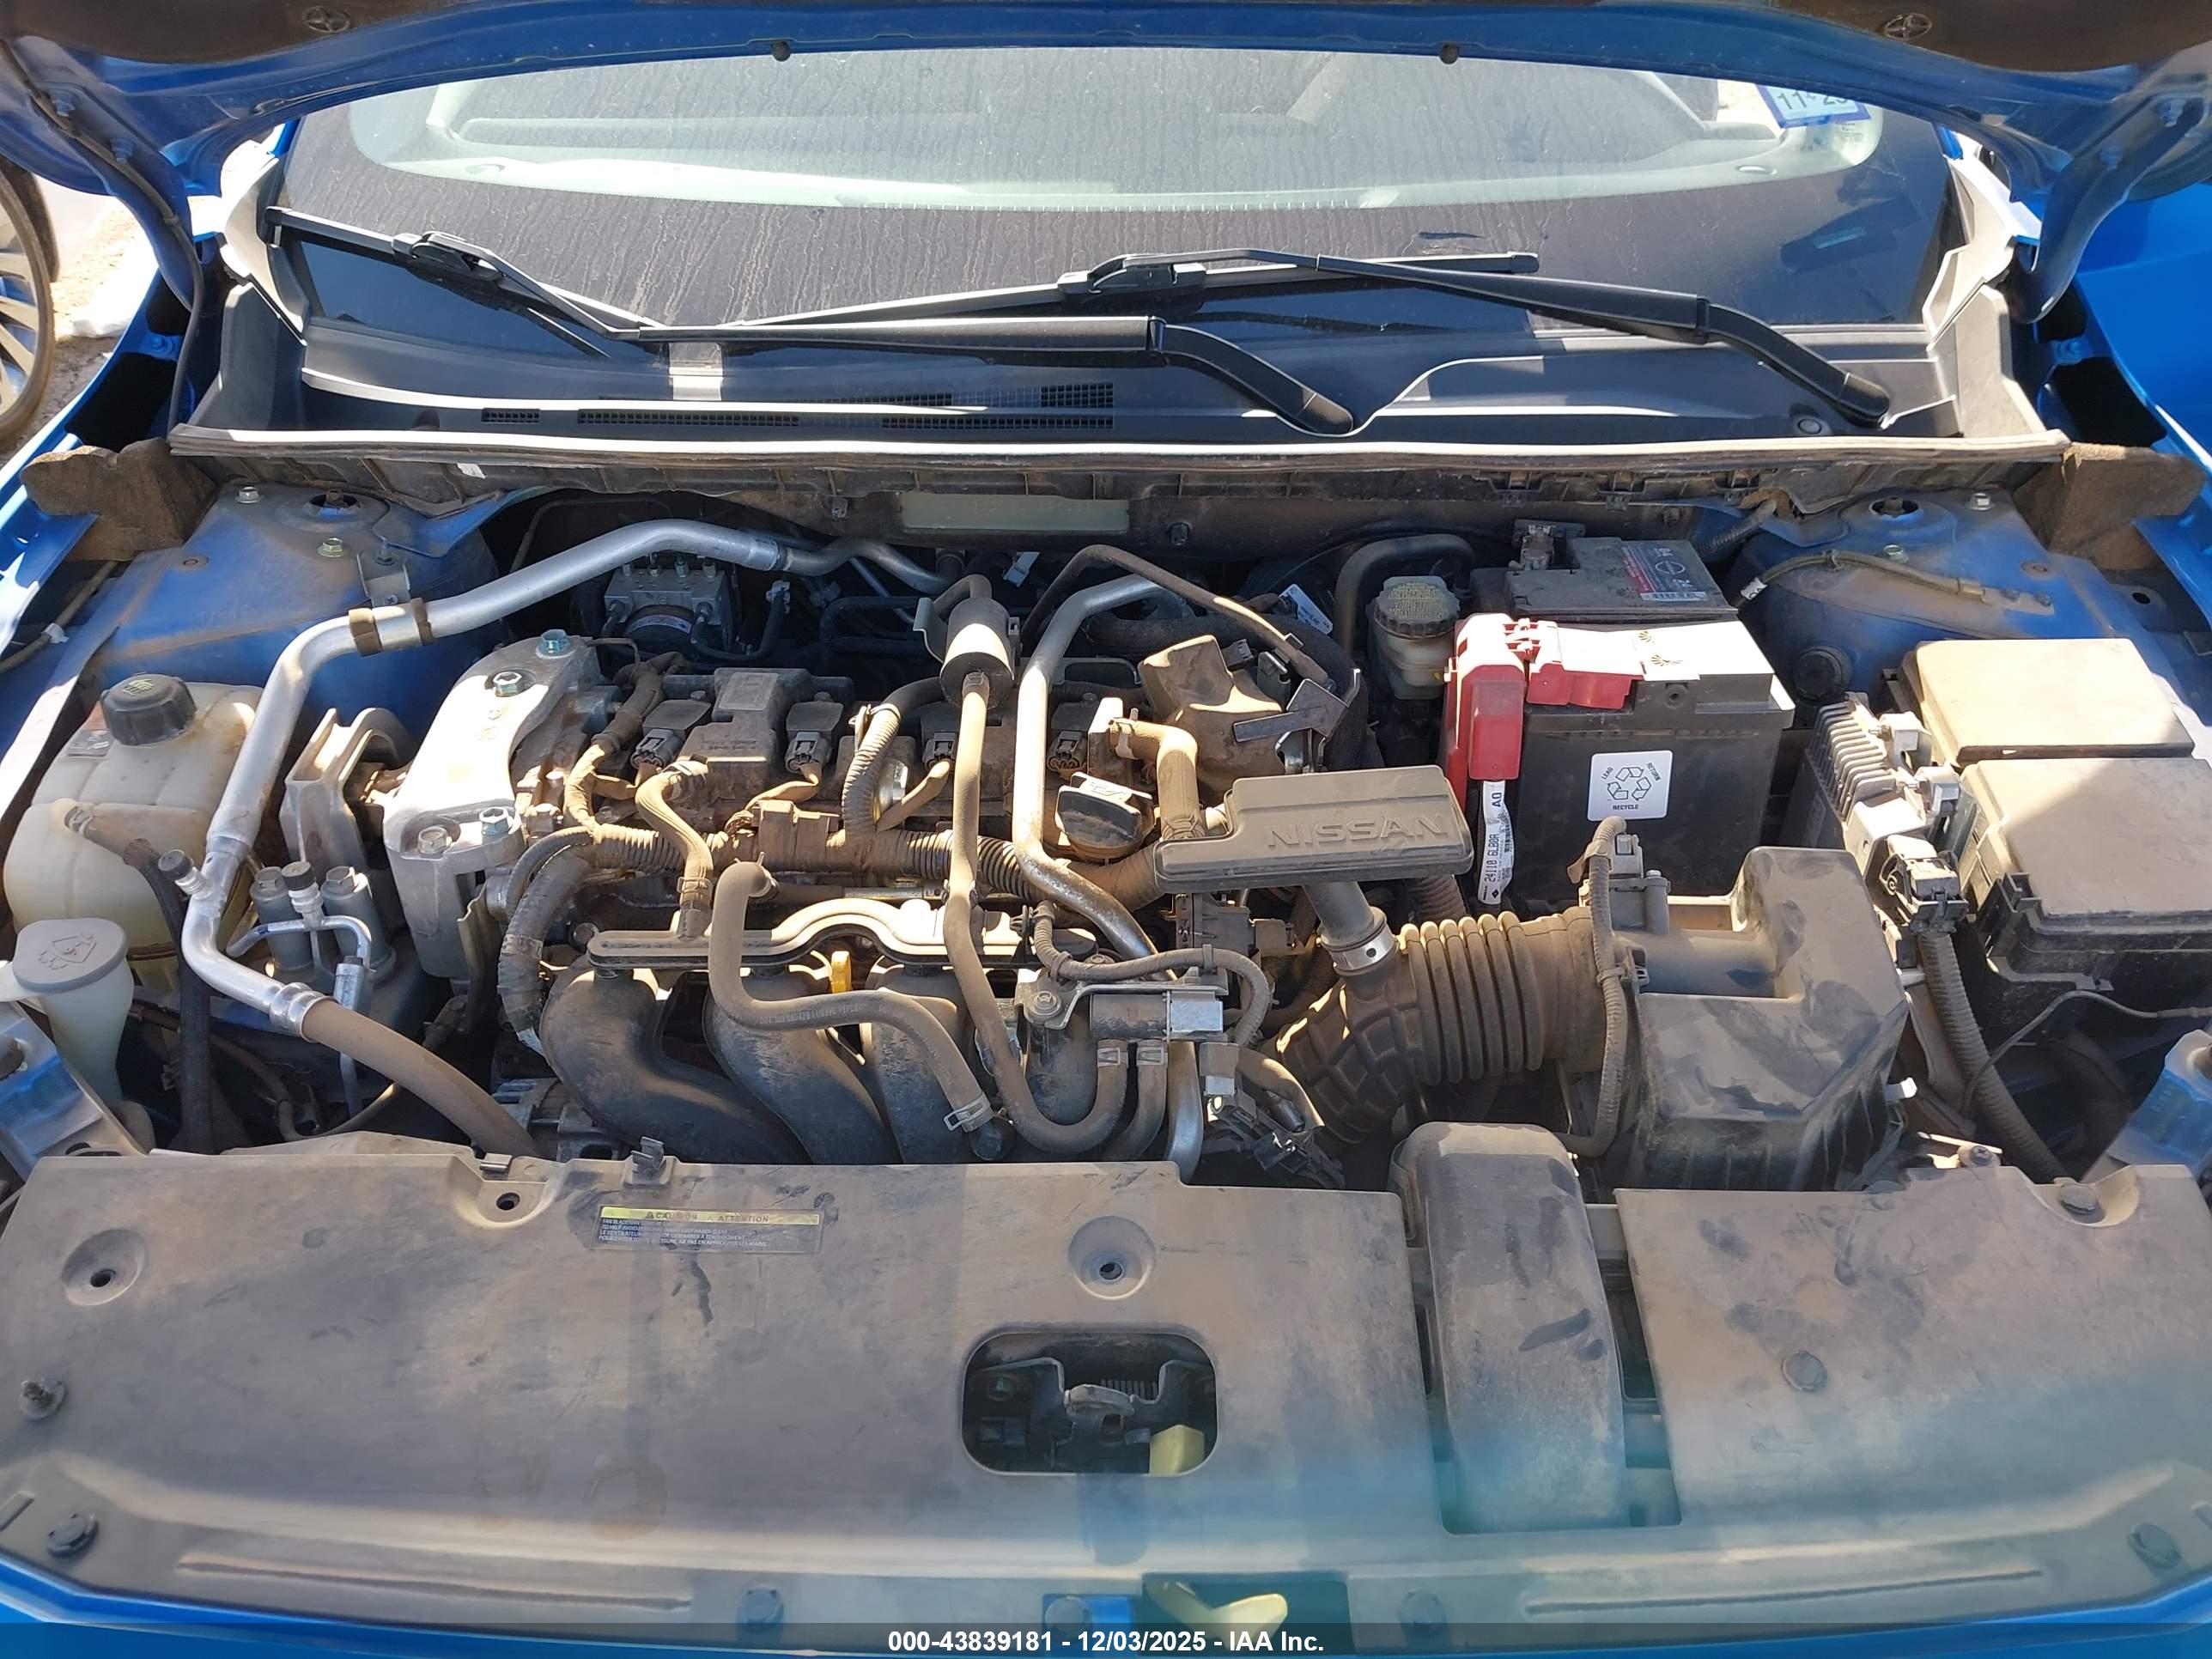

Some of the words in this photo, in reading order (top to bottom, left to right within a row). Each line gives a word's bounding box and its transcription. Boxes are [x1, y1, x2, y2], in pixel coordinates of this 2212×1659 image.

[1601, 766, 1613, 781] LEAD
[1646, 762, 1662, 781] RETURN
[1267, 813, 1448, 847] NISSAN
[1484, 860, 1497, 883] 24110
[656, 1212, 697, 1220] CAUON
